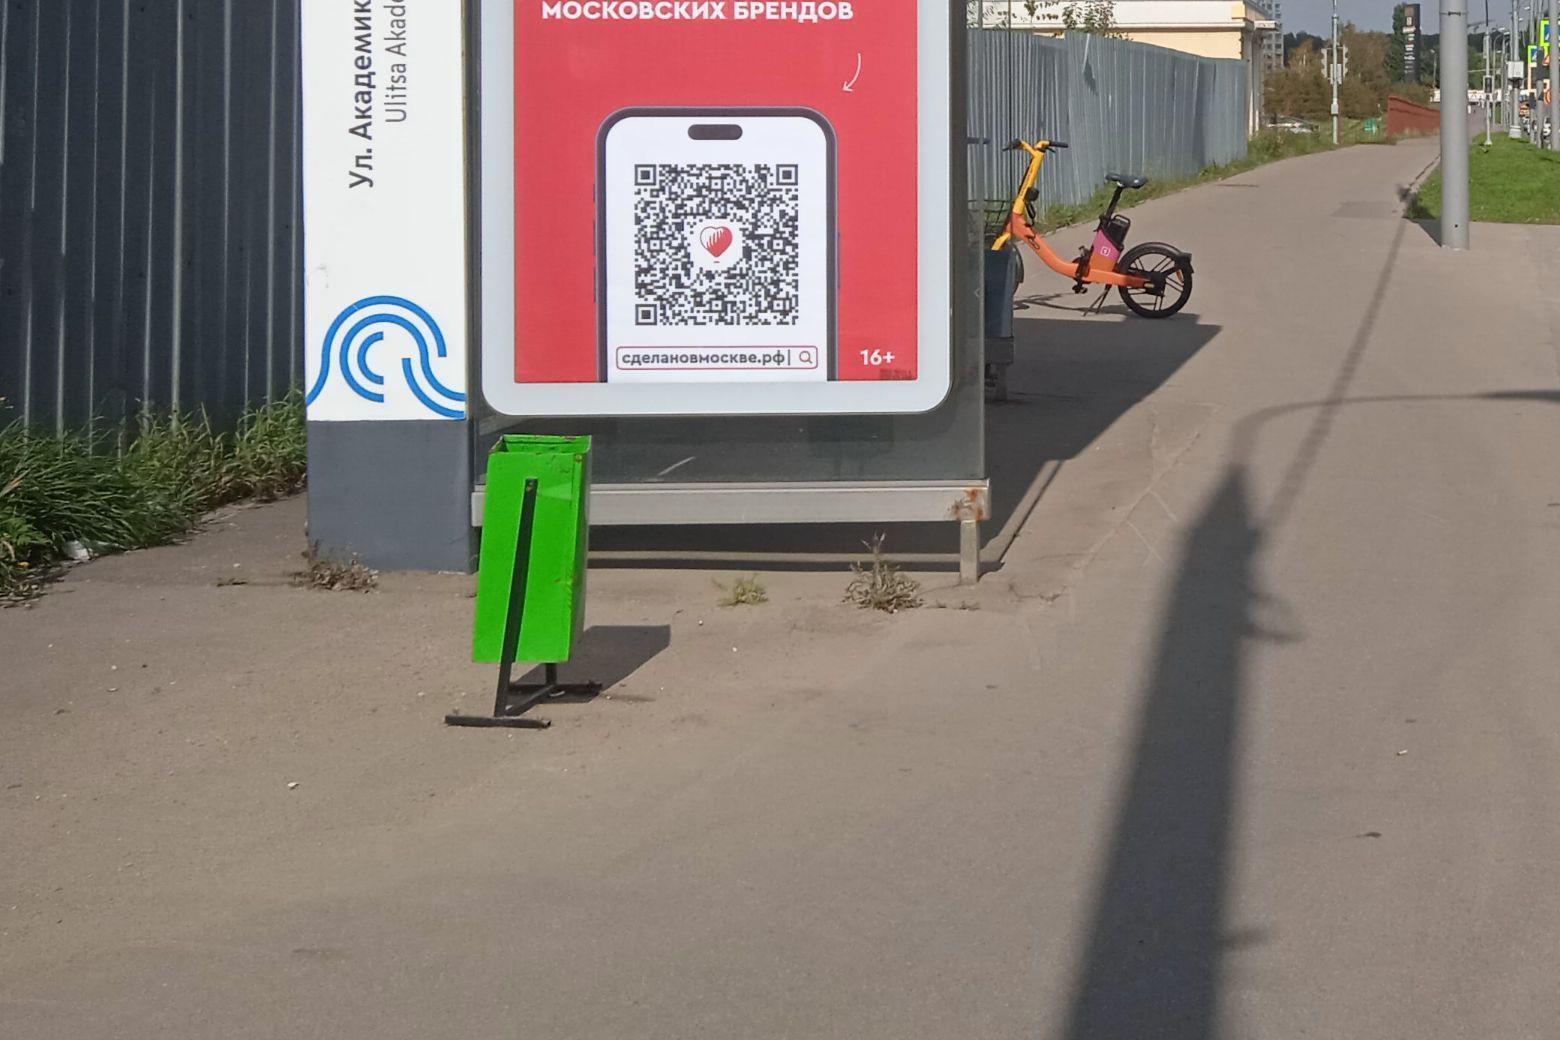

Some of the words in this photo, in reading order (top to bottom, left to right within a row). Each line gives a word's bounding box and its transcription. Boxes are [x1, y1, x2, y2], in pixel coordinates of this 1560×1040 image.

[541, 0, 728, 20] МОСКОВСКИХ
[733, 1, 854, 24] БРЕНДОВ
[383, 63, 408, 123] Ulitsa
[348, 147, 375, 189] Ул.
[621, 350, 785, 366] сделановмоскве.рф
[860, 349, 896, 366] 16+
